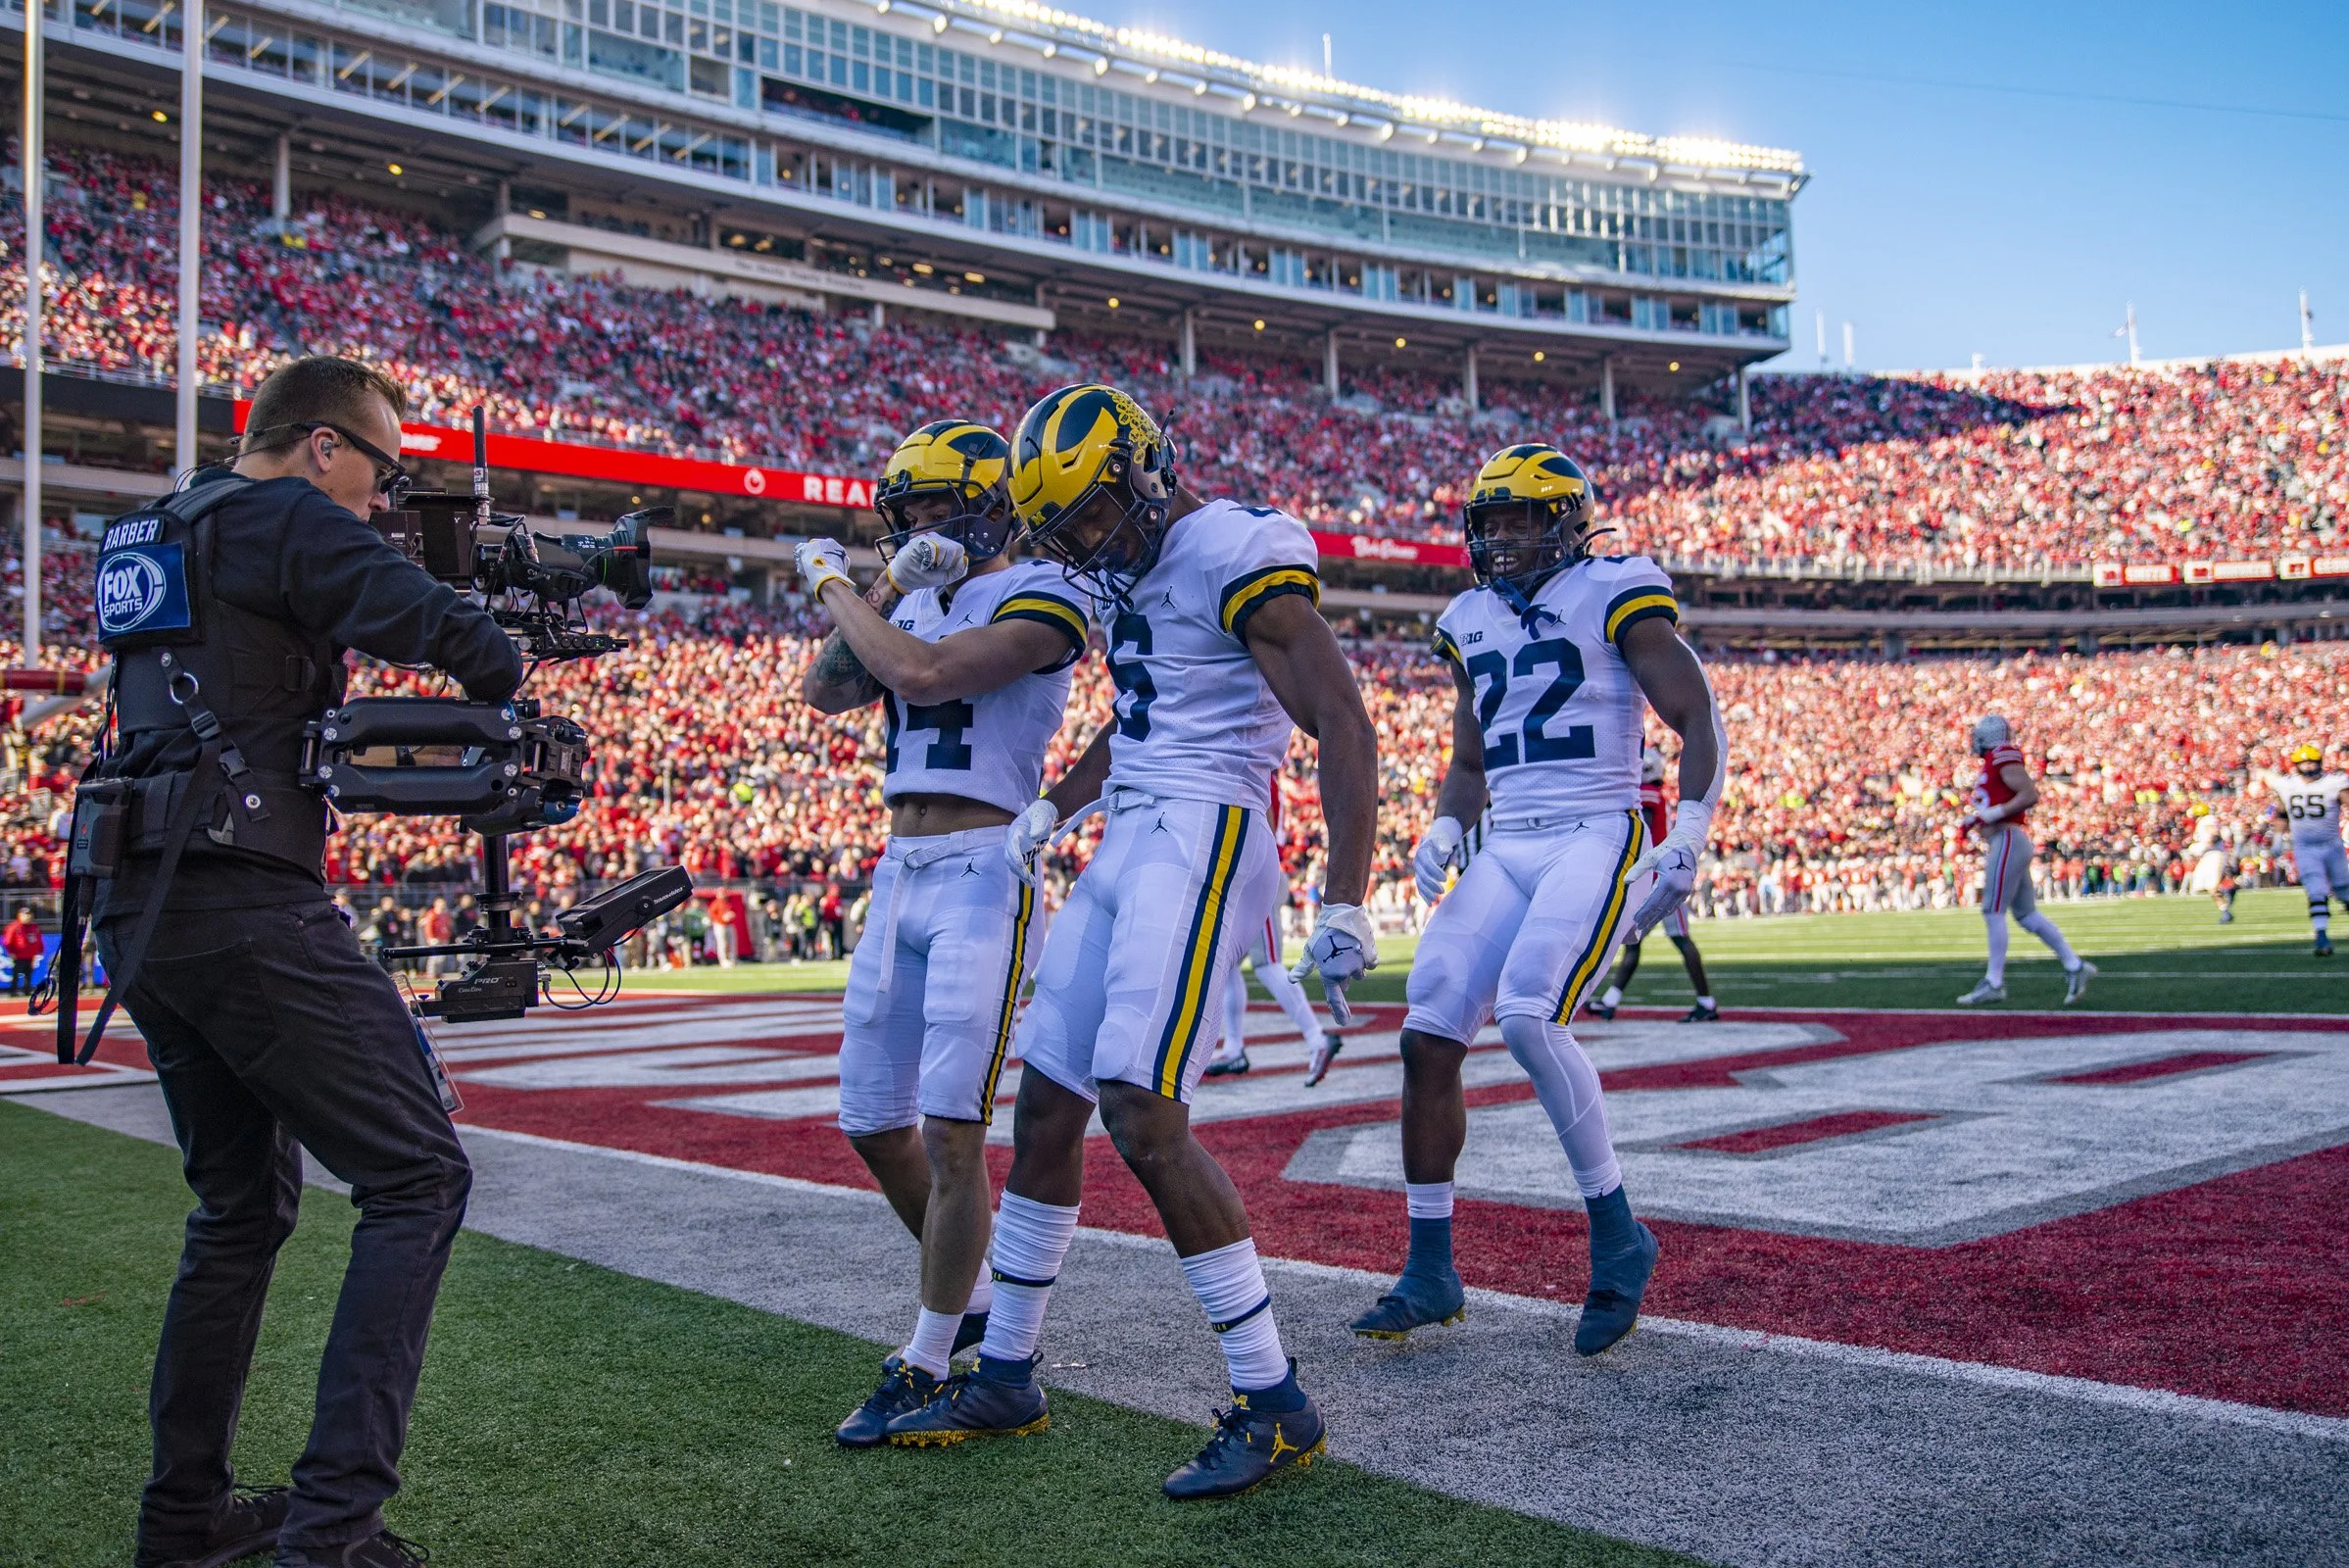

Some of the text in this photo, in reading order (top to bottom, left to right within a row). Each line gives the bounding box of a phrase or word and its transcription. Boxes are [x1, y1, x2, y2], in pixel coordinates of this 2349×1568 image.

[103, 519, 159, 552] BARBER
[104, 565, 142, 605] FOX
[104, 597, 143, 617] SPORTS
[1105, 613, 1157, 742] 6
[1466, 638, 1595, 771] 22
[2290, 795, 2325, 819] 65
